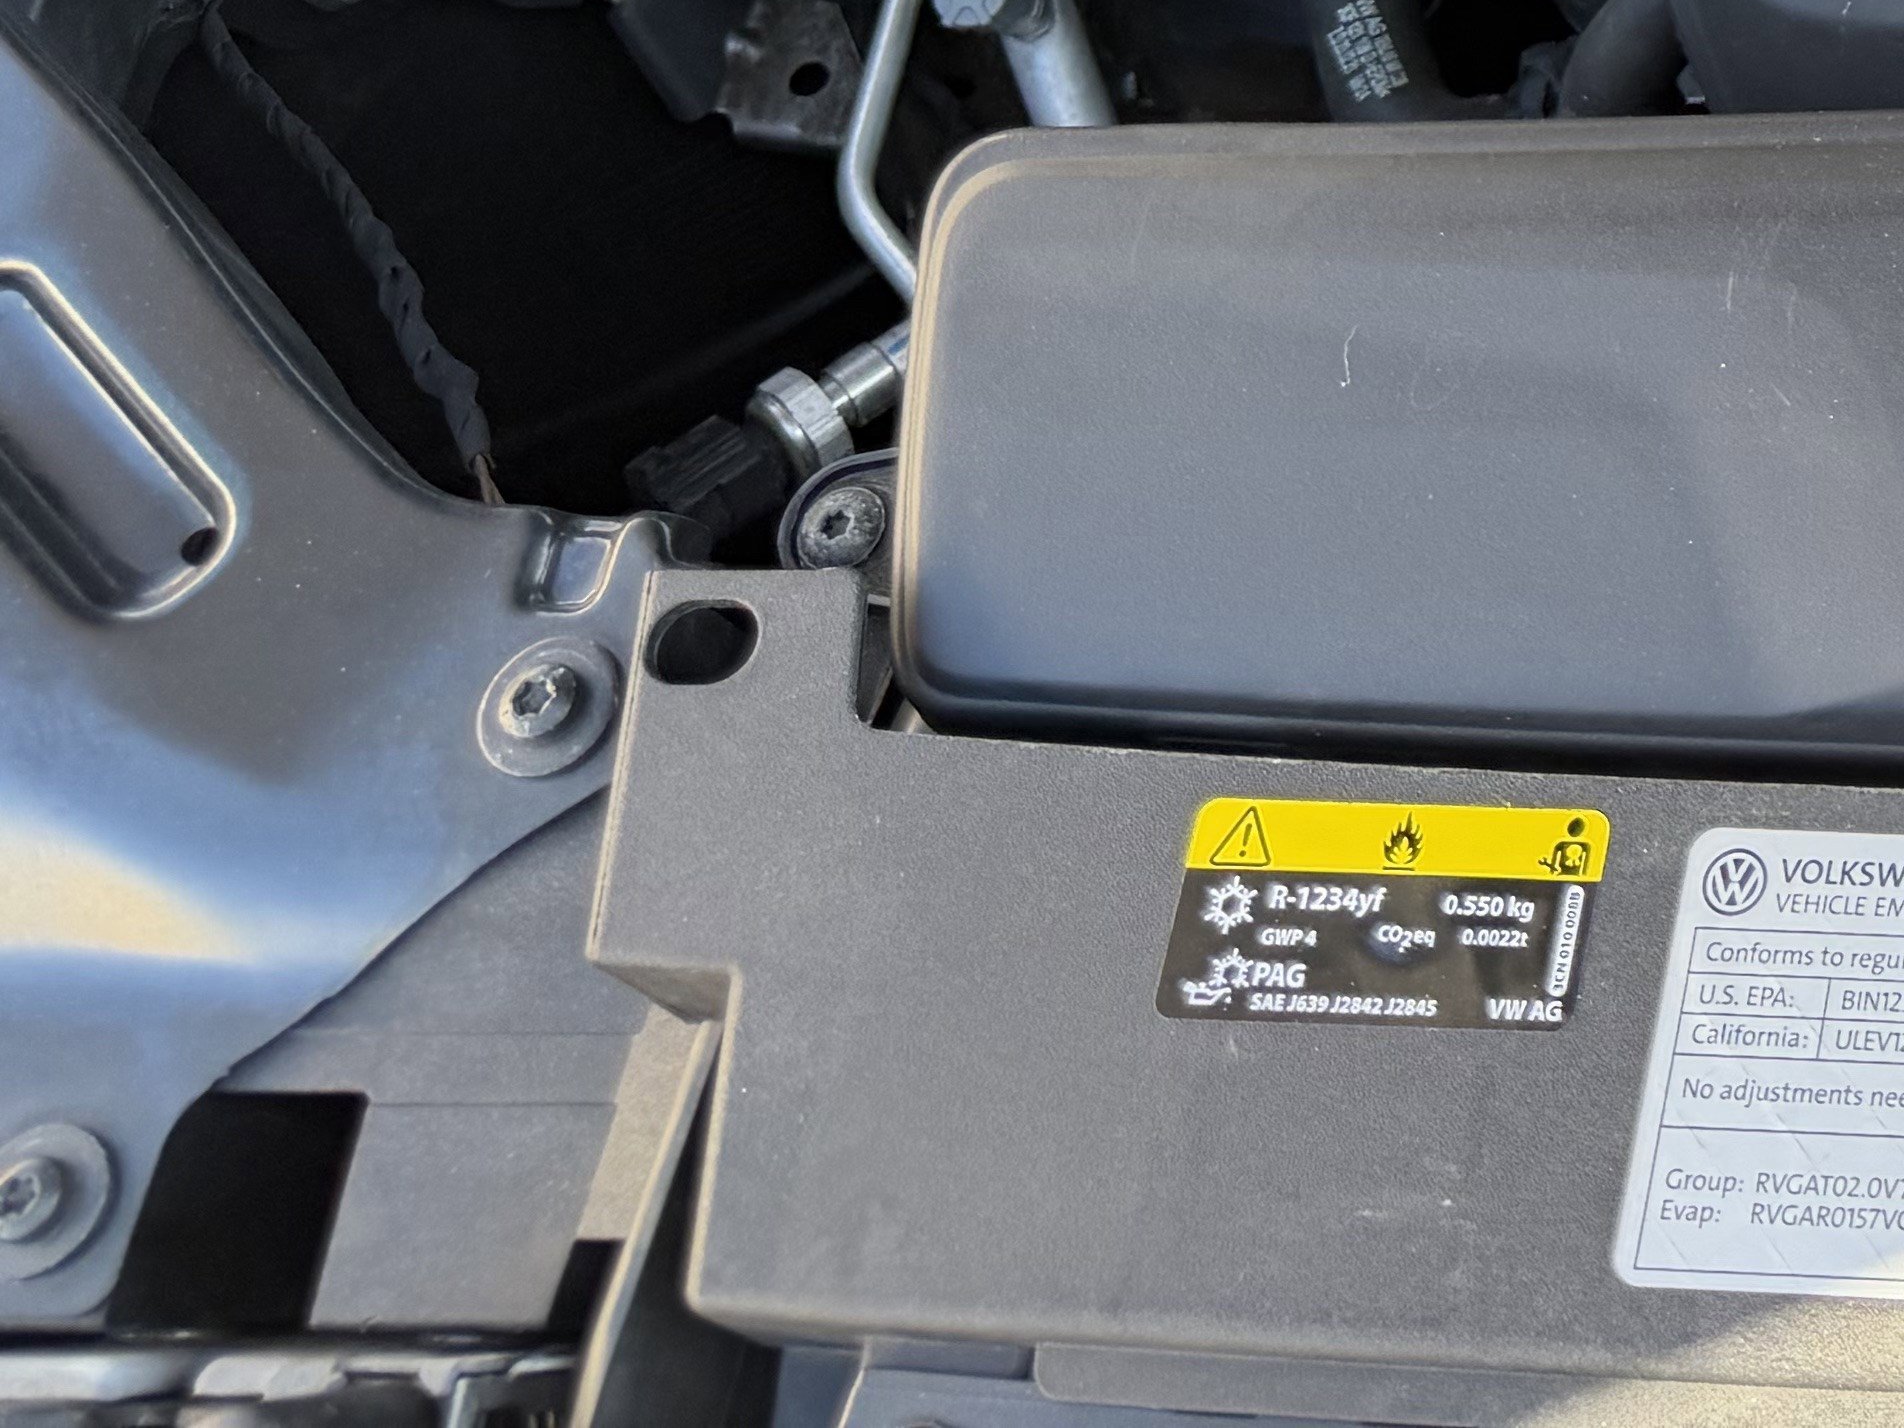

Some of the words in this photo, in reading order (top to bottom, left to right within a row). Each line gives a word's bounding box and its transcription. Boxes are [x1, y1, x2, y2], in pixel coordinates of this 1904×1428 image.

[1268, 885, 1388, 918] R-1234yf
[1442, 894, 1504, 917] 0.550
[1506, 897, 1536, 922] kg
[1775, 892, 1868, 917] VEHICLE
[1260, 927, 1303, 946] GWP
[1304, 929, 1318, 947] 4
[1705, 941, 1815, 966] Conforms
[1820, 946, 1844, 968] to
[1252, 963, 1307, 988] PAG
[1248, 993, 1285, 1012] SAE
[1286, 993, 1329, 1014] J639
[1330, 995, 1383, 1015] J2842
[1384, 997, 1438, 1017] J2845
[1698, 983, 1739, 1006] U.S.
[1745, 985, 1795, 1009] EPA:
[1487, 998, 1530, 1020] VW
[1532, 999, 1564, 1022] AG
[1691, 1022, 1810, 1050] California:
[1681, 1077, 1714, 1100] No
[1719, 1078, 1864, 1108] adjustments
[1664, 1167, 1745, 1199] Group:
[1659, 1198, 1721, 1229] Evap:
